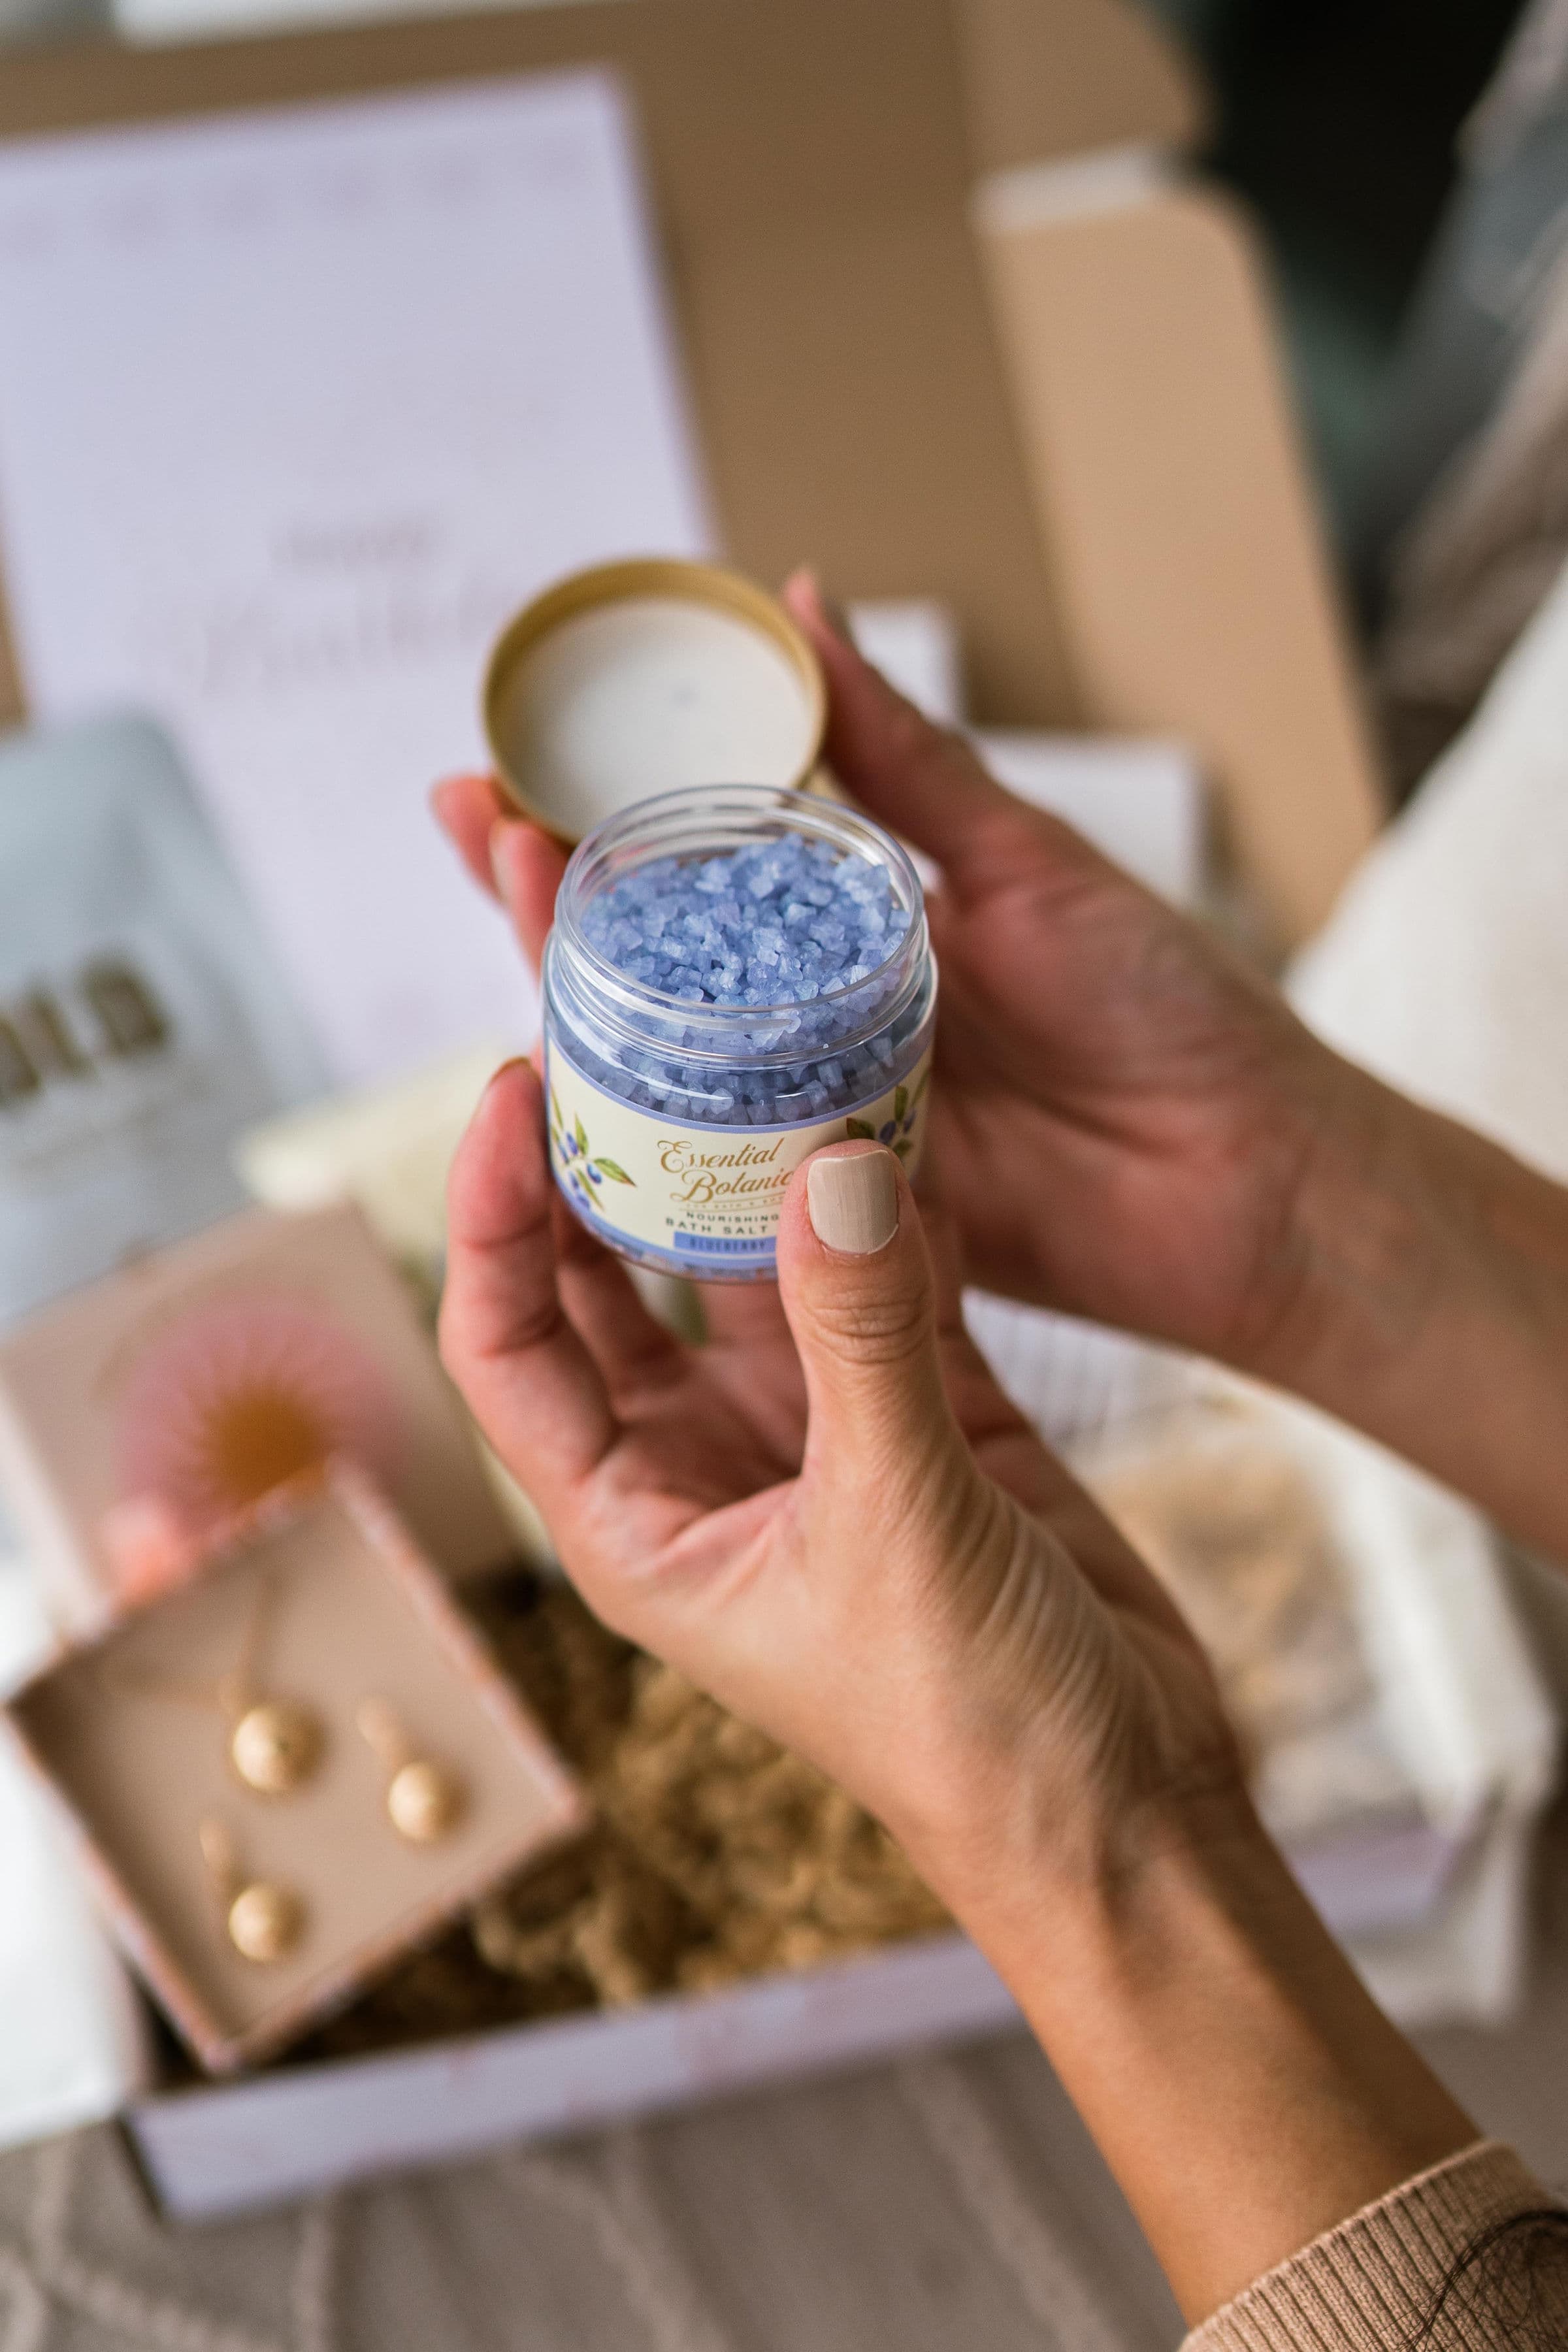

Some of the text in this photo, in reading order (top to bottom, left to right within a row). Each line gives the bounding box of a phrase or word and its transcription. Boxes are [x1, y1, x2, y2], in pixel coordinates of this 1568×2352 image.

[657, 1137, 785, 1173] Essential
[687, 1211, 779, 1222] NOURISHING
[666, 1217, 768, 1235] BATH SALT
